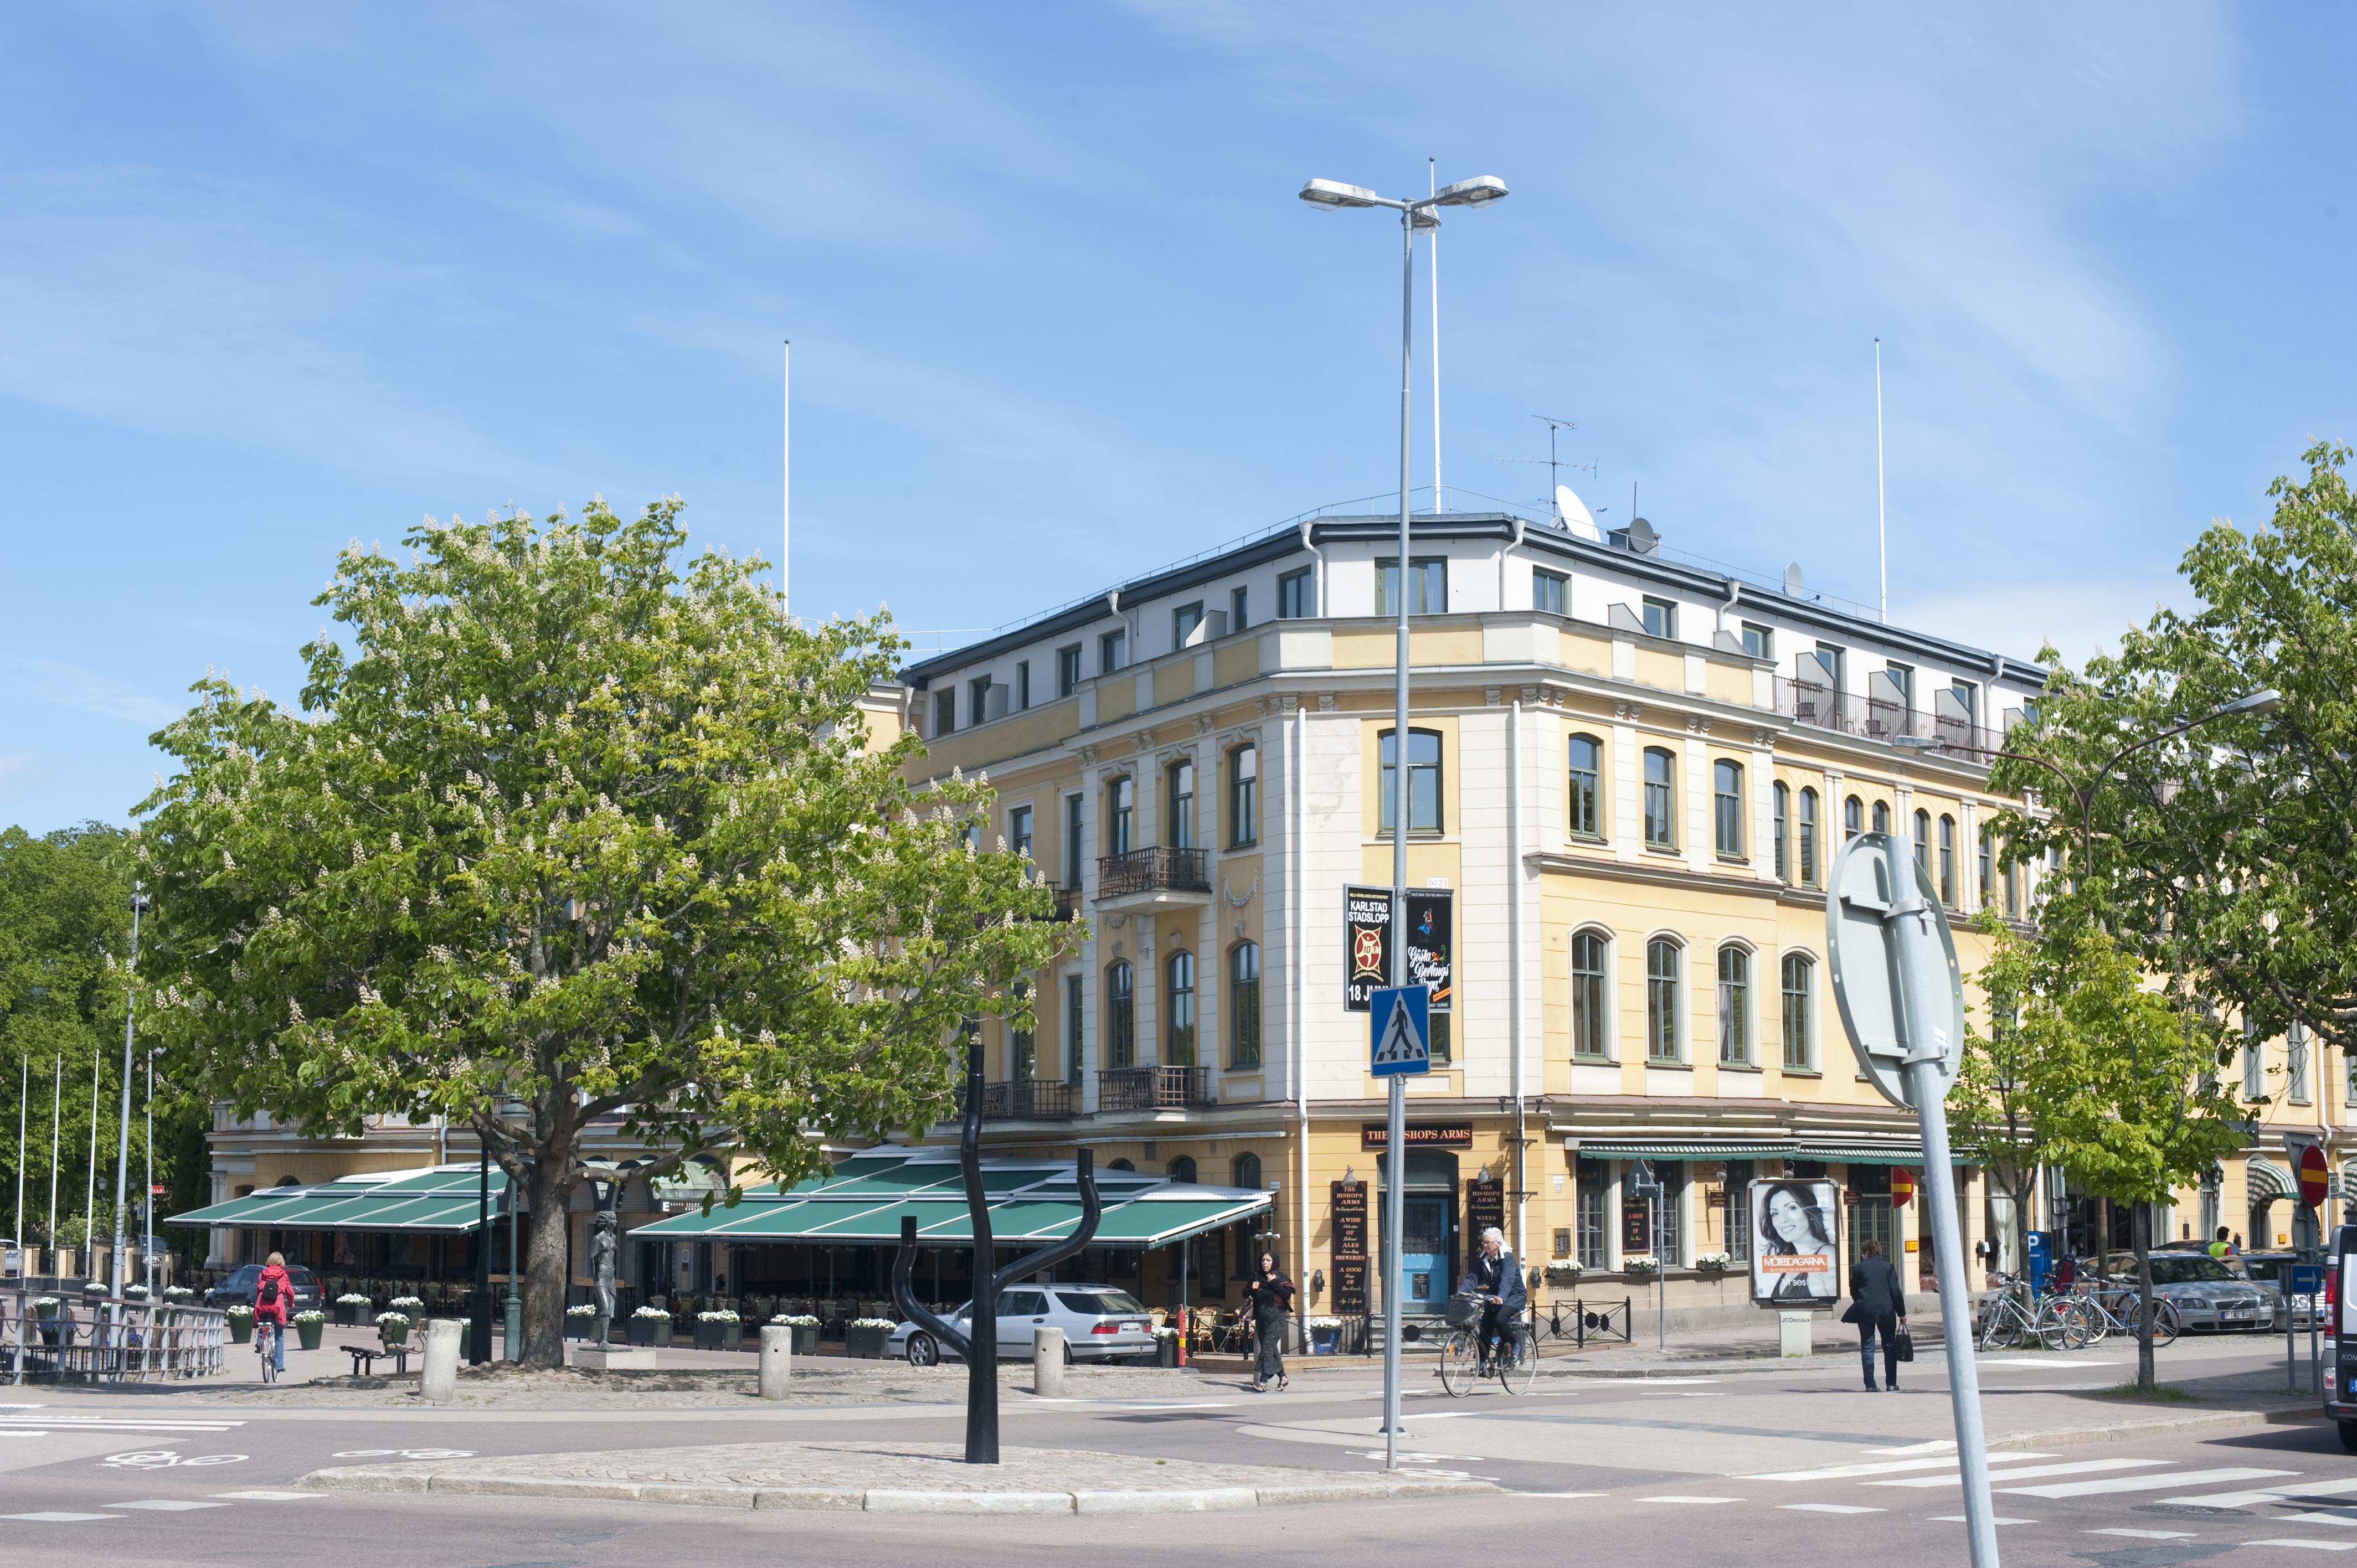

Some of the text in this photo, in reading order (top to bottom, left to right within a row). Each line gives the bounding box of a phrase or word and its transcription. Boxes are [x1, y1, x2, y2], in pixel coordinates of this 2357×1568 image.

[1350, 900, 1388, 912] KARLSTAD
[1349, 911, 1390, 924] STADSLOPP
[1372, 946, 1379, 954] KM
[1408, 946, 1431, 968] Gösta
[1414, 962, 1450, 984] Berlings
[1349, 984, 1361, 1001] 18
[1367, 1129, 1470, 1140] THE SHOPS ARMS
[662, 1201, 670, 1211] E
[2027, 1235, 2039, 1252] P
